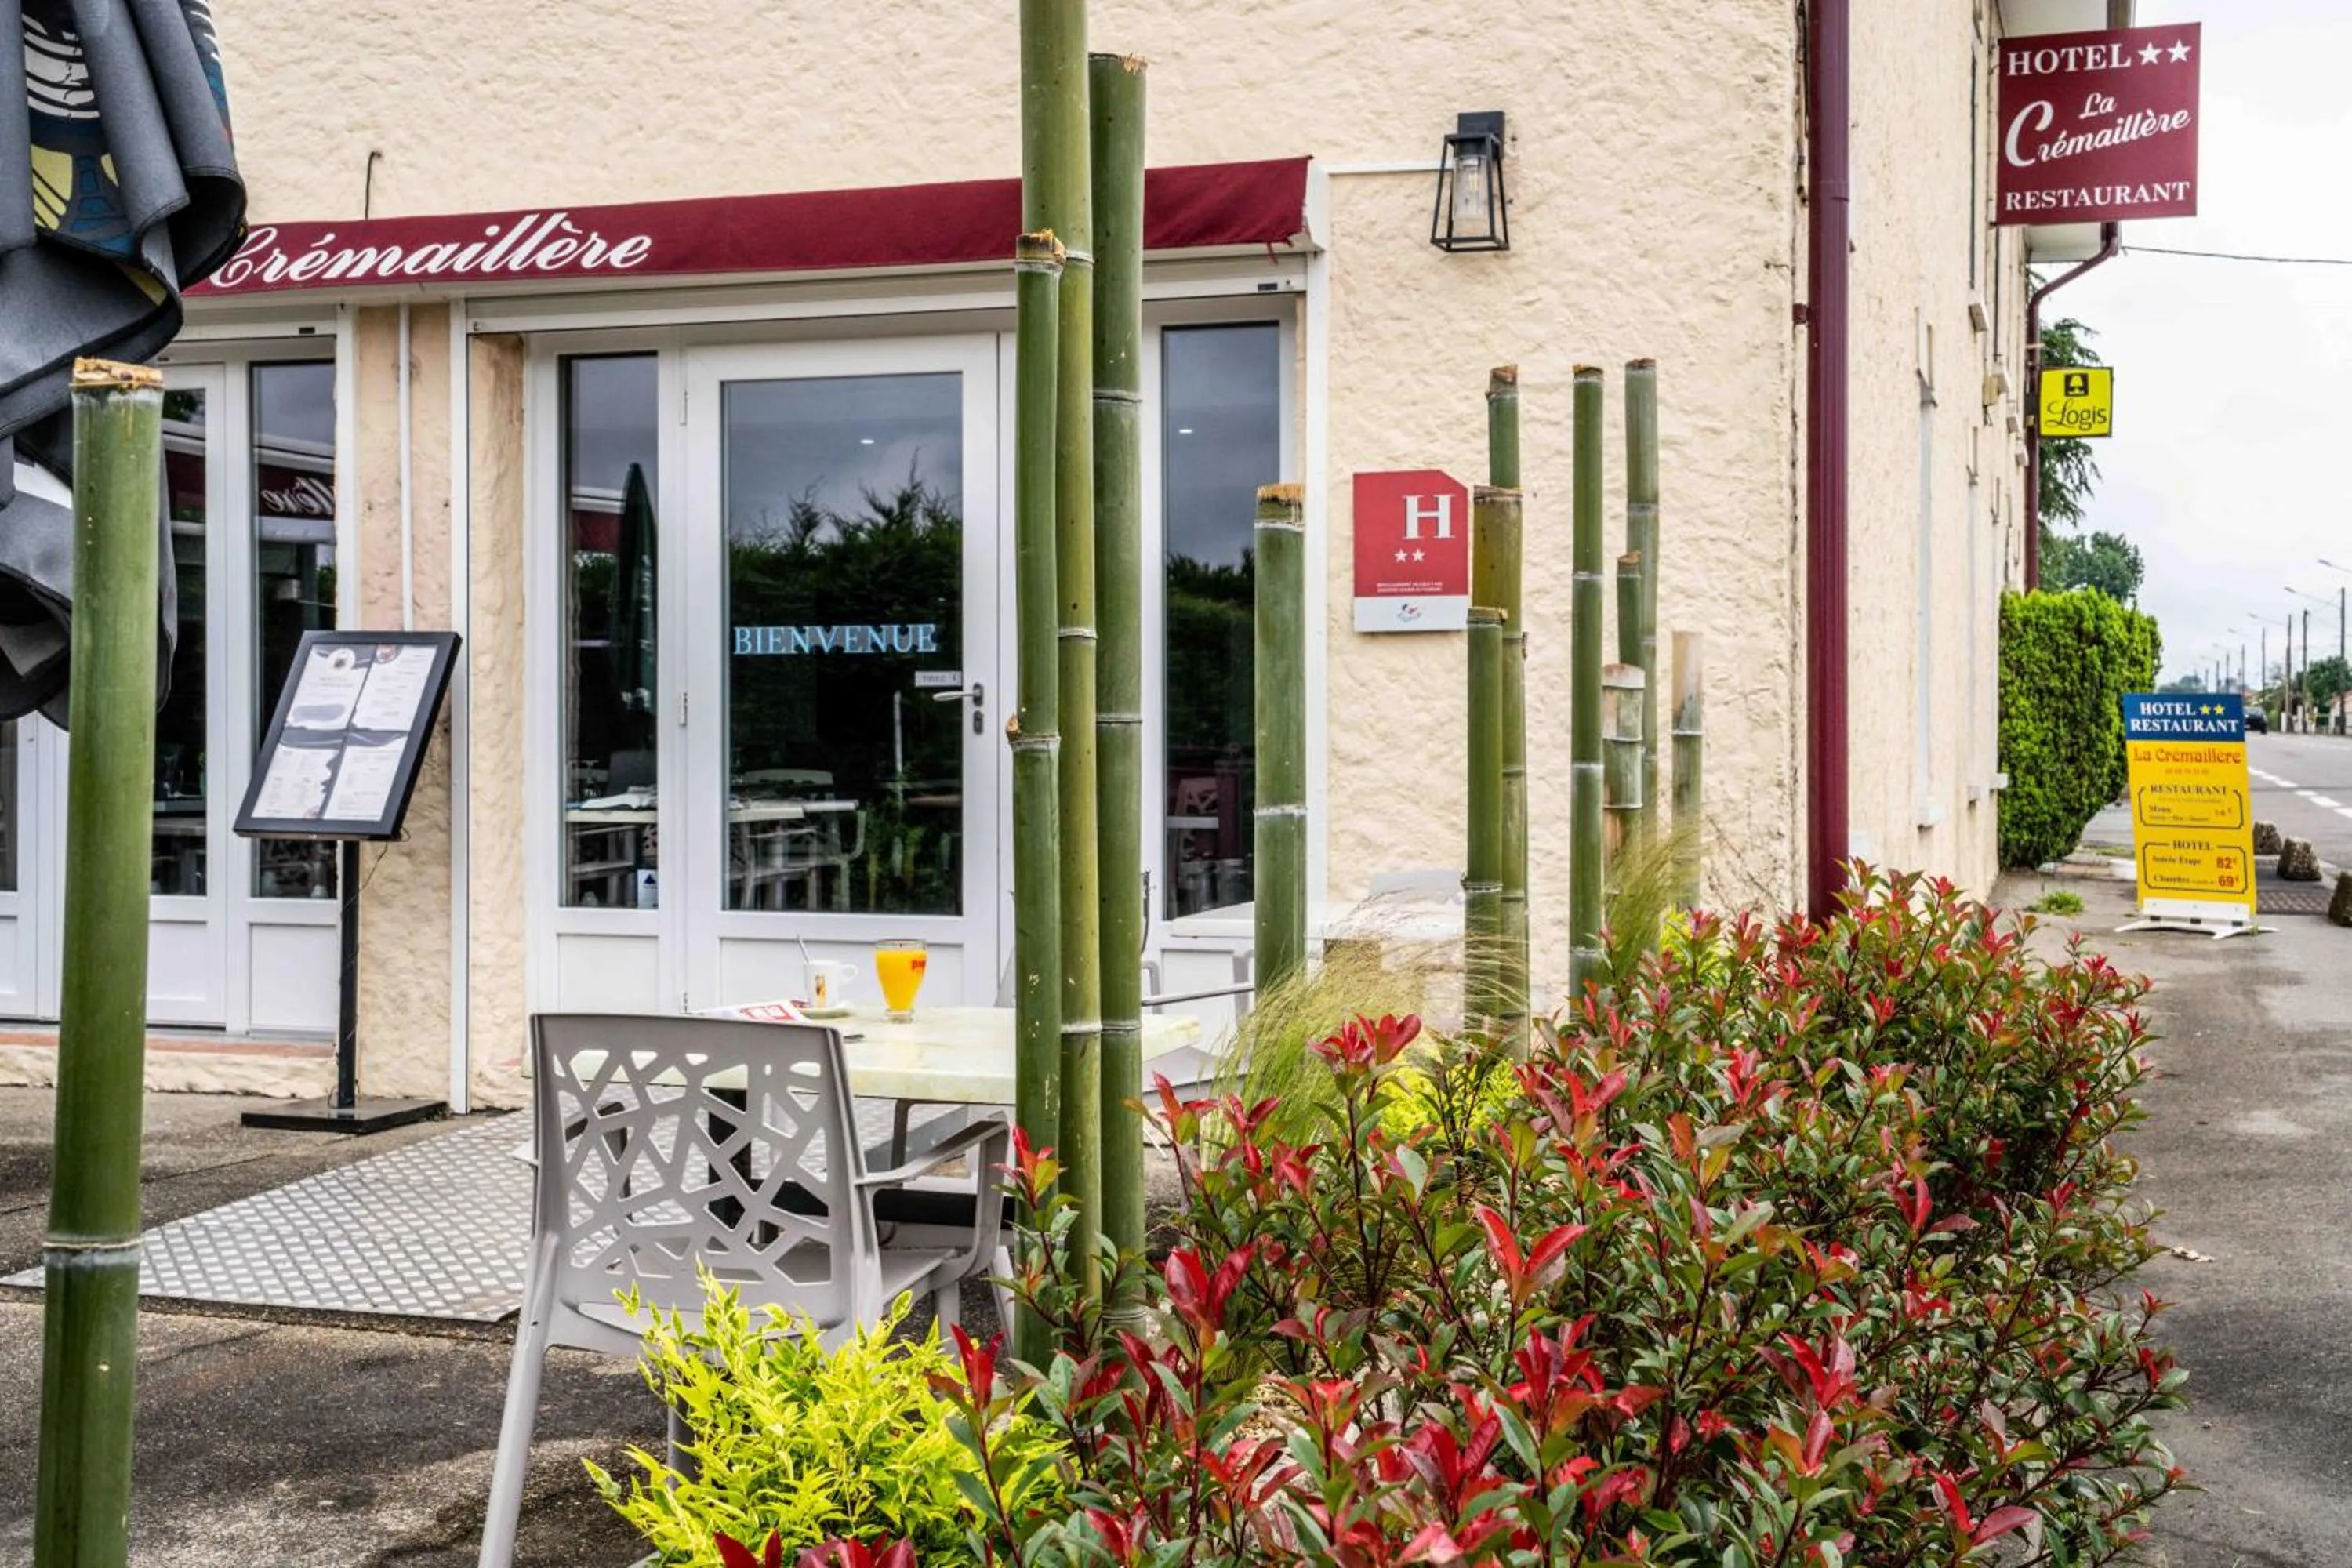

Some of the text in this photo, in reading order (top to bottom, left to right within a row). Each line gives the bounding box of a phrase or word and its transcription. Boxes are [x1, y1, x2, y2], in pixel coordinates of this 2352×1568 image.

[2007, 43, 2132, 76] HOTEL
[2079, 93, 2115, 119] La
[2005, 100, 2191, 167] Crémaillère
[2005, 181, 2190, 211] RESTAURANT
[209, 212, 652, 288] Crémaillère
[2045, 398, 2107, 431] Logis
[1402, 494, 1456, 539] H
[734, 624, 937, 655] BIENVENUE
[2140, 702, 2196, 716] HOTEL
[2130, 719, 2239, 733] RESTAURANT
[2134, 747, 2151, 762] La
[2151, 785, 2227, 796] RESTAURANT
[2172, 840, 2213, 851] HOTEL
